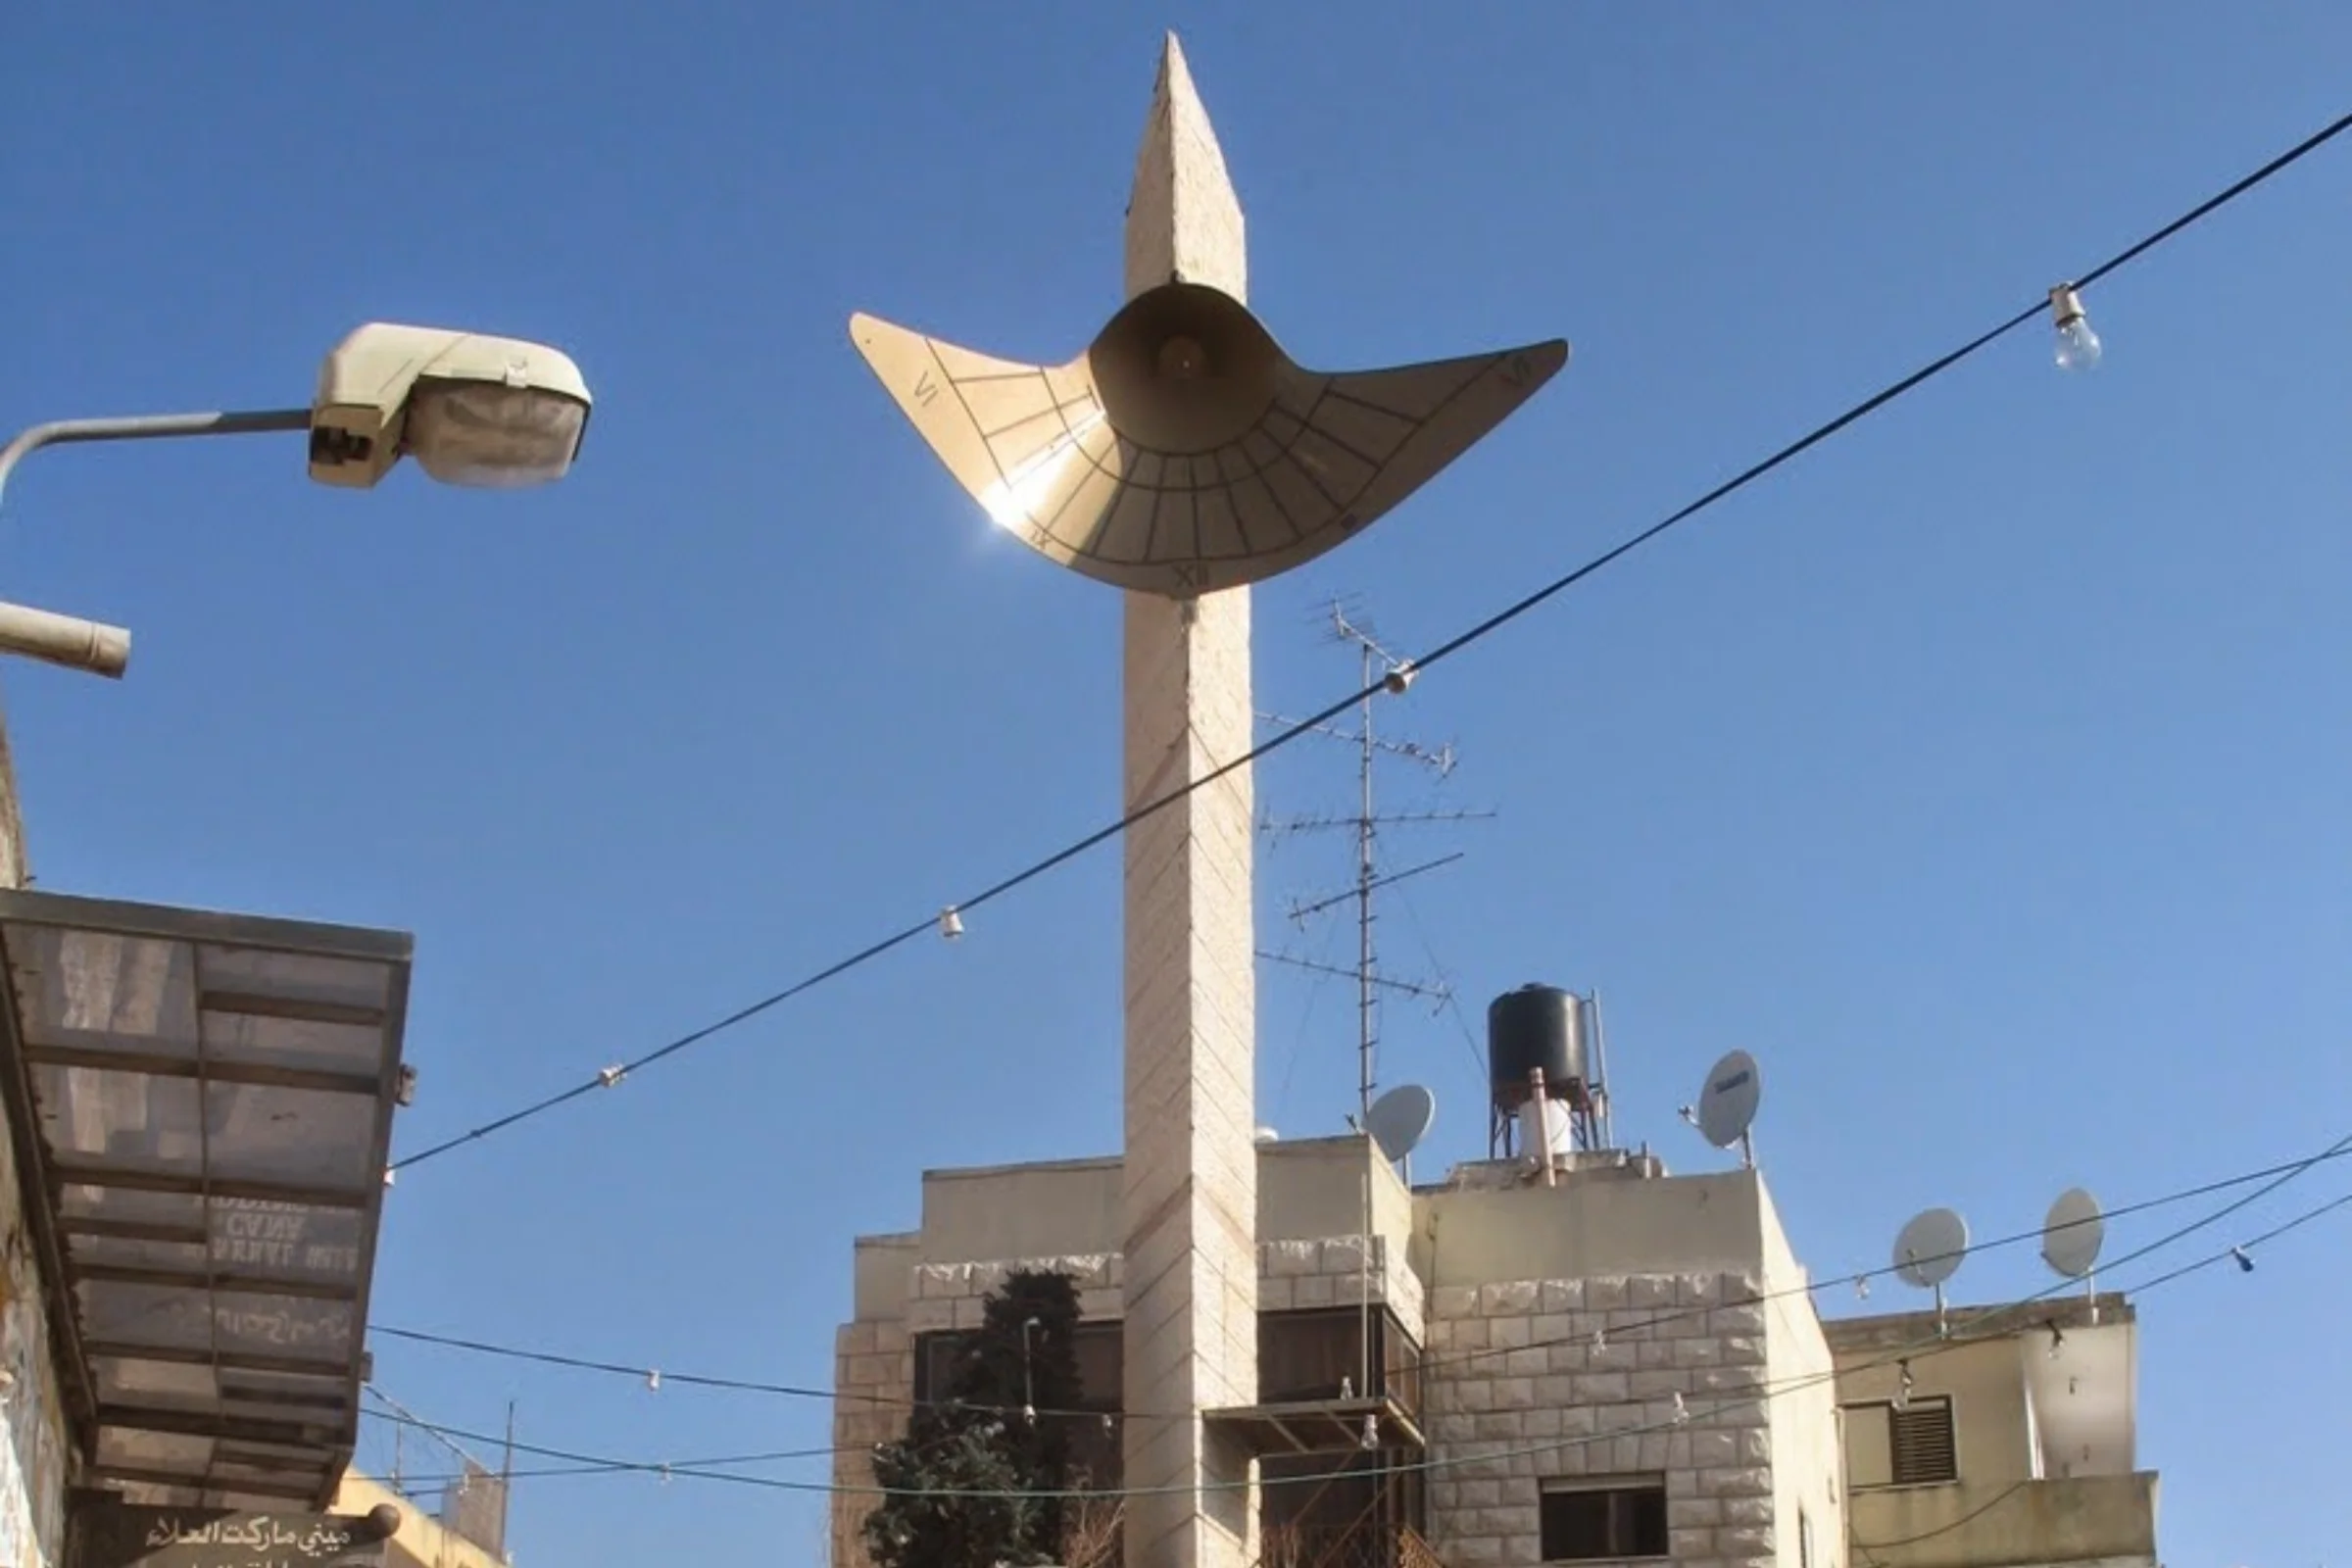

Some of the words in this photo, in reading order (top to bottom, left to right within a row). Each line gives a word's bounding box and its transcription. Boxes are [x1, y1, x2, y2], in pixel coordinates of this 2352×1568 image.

[913, 369, 939, 408] VI
[221, 1516, 296, 1551] ماركت
[297, 1522, 351, 1557] ميني
